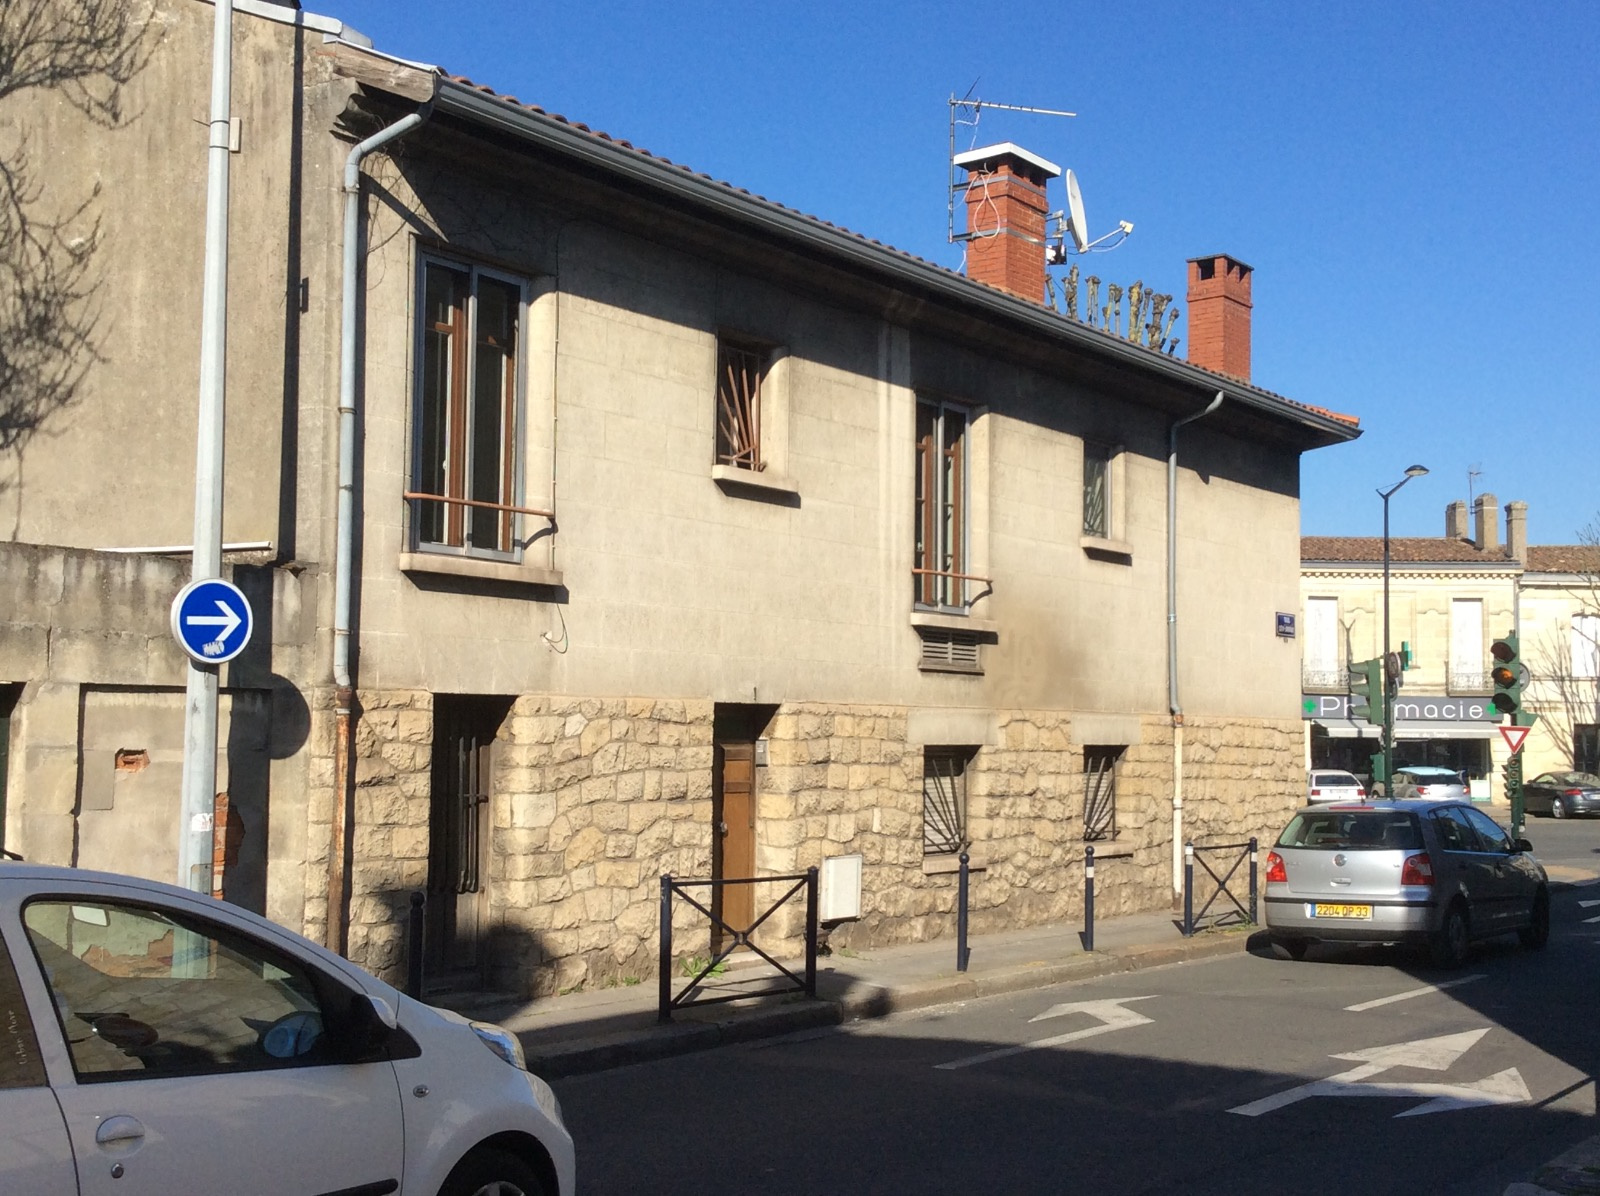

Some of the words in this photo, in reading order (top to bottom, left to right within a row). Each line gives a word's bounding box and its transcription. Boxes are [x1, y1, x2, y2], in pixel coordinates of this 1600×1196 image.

[1320, 696, 1484, 719] Phmacie
[1317, 905, 1340, 916] 2204
[1356, 906, 1368, 917] 33
